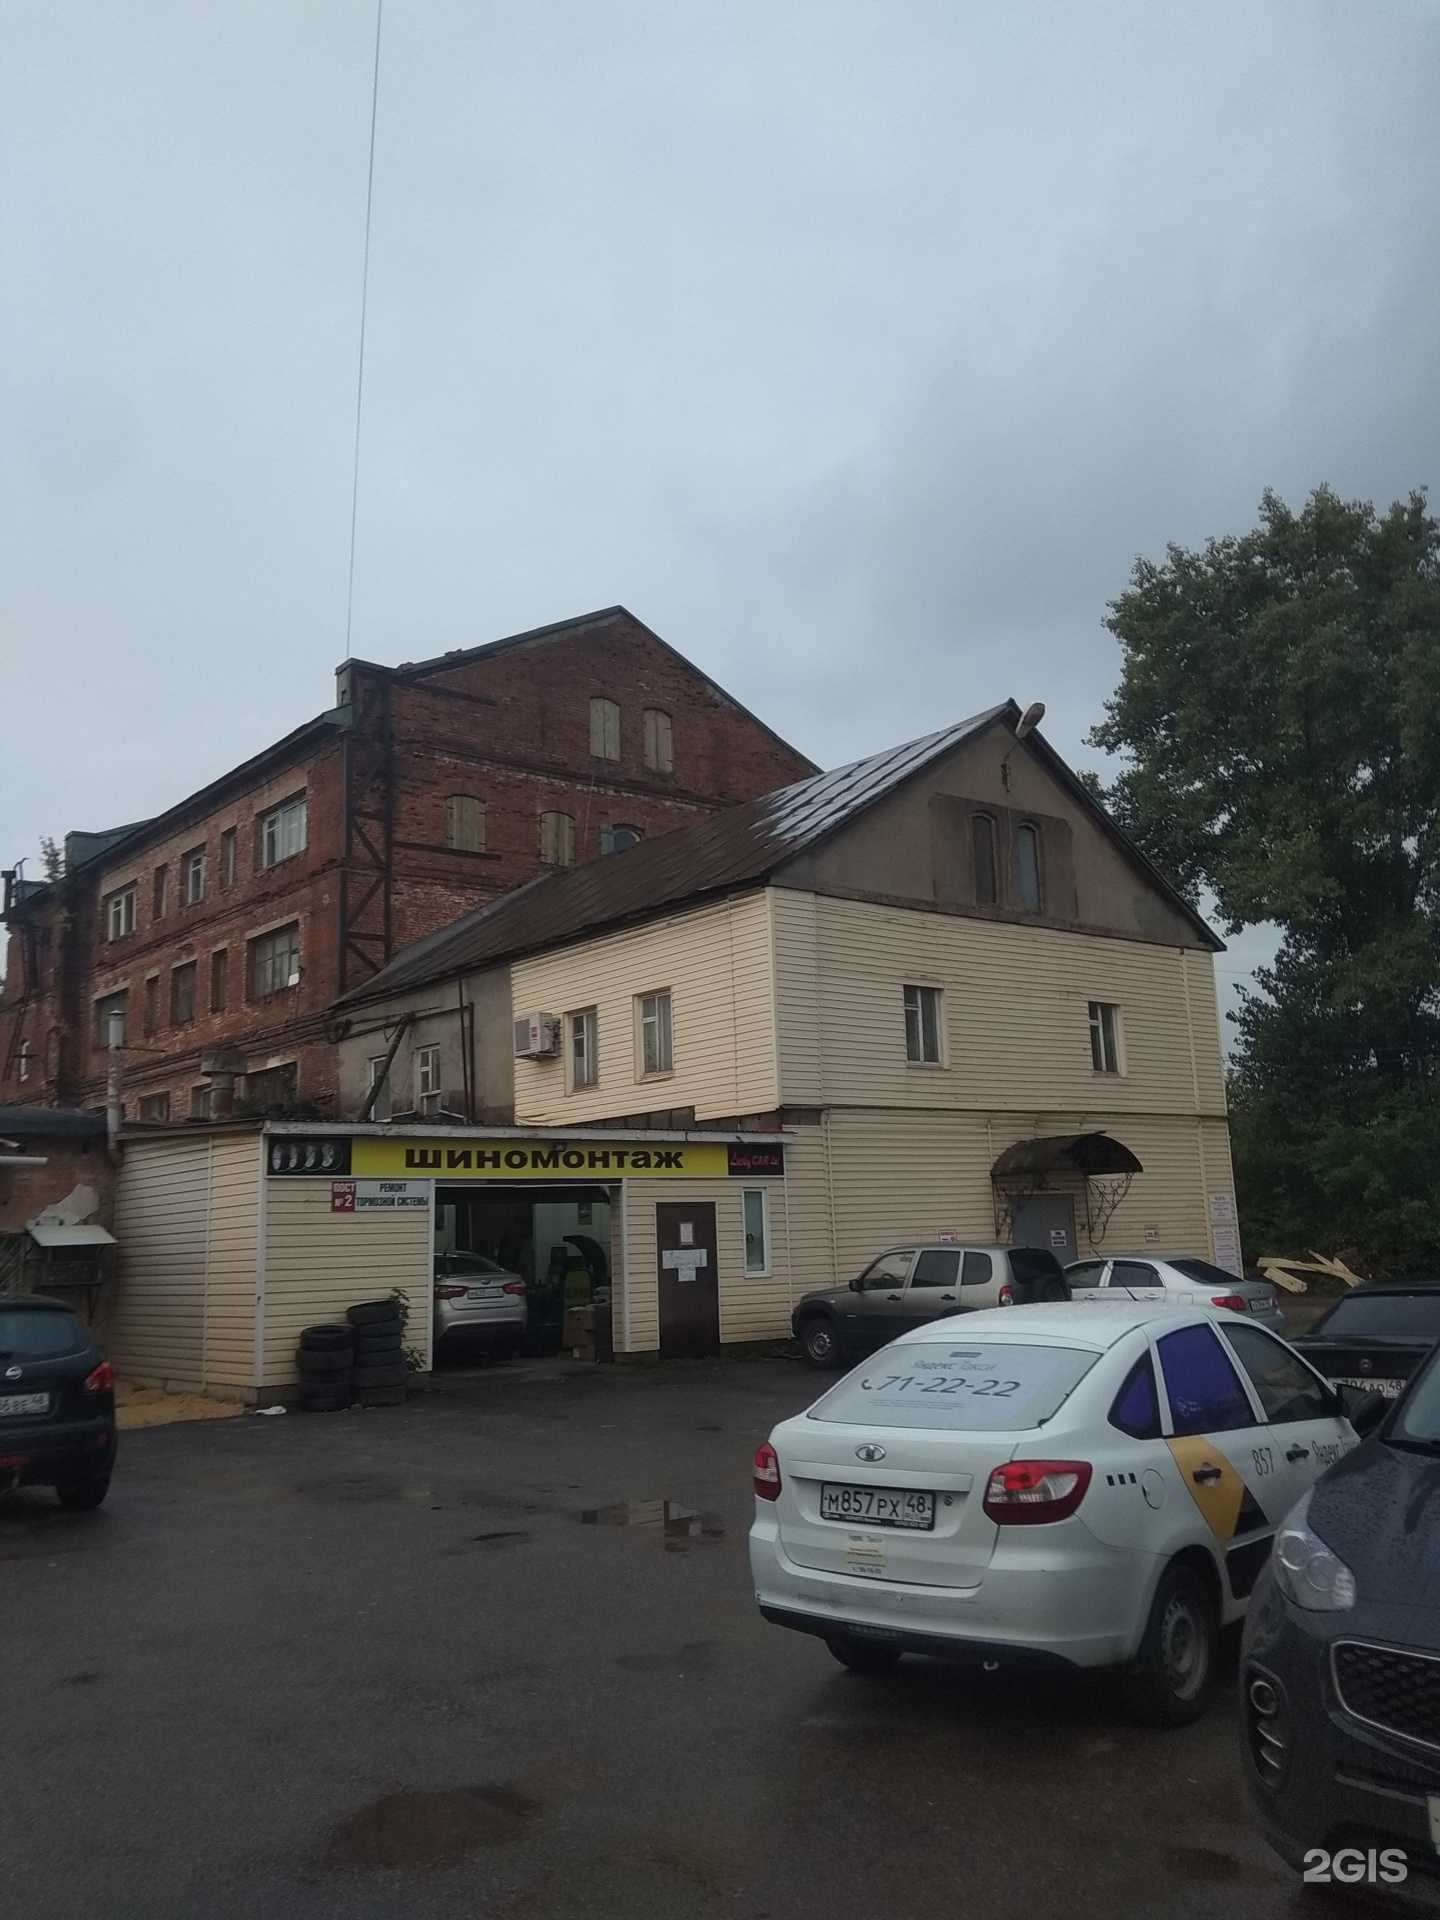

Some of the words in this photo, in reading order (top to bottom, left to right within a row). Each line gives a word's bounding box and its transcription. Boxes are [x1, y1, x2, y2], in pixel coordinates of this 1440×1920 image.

[877, 1375, 1022, 1398] 71-22-22
[1252, 1447, 1275, 1477] 857
[827, 1489, 900, 1519] М857РХ
